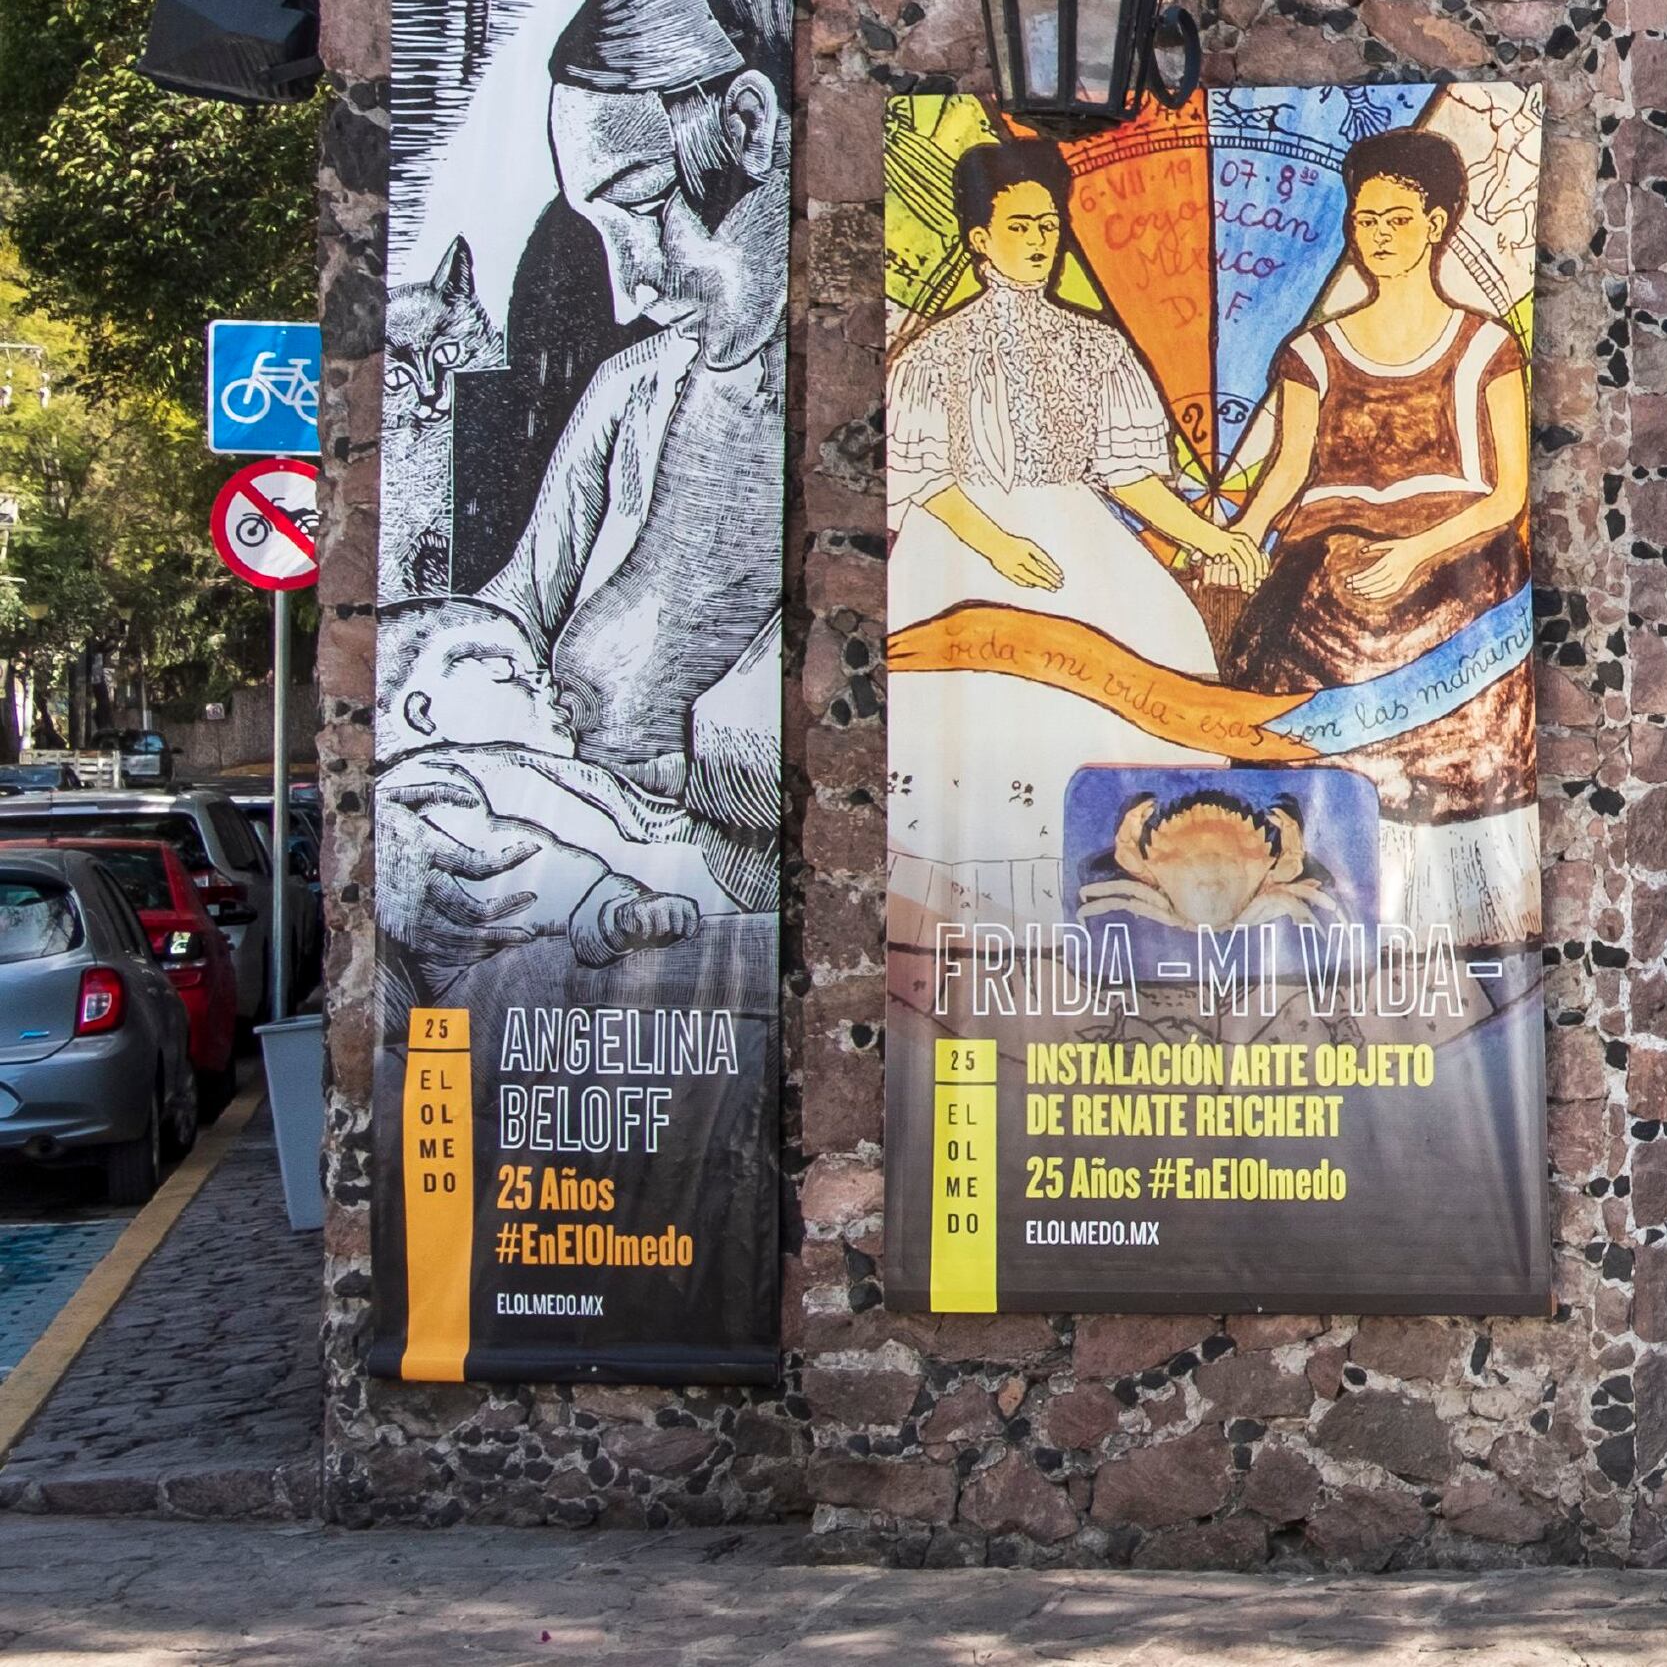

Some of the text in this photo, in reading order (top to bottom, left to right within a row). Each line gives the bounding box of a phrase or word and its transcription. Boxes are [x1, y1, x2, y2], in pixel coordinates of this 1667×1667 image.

[935, 922, 1140, 1017] FRIDA
[424, 1019, 449, 1039] 25
[500, 1006, 739, 1075] ANGELINA
[420, 1070, 453, 1091] EL
[950, 1050, 976, 1072] 25
[1026, 1034, 1434, 1088] INSTALACIÓN ARTE OBJETO
[500, 1085, 673, 1153] BELOFF
[947, 1104, 977, 1126] EL
[1026, 1095, 1343, 1138] DE RENATE REICHERT
[496, 1164, 615, 1212] 25 Años
[1026, 1157, 1347, 1202] 25 Años #EnElOlmedo
[495, 1222, 693, 1267] #EnElOlmedo
[1026, 1220, 1159, 1246] ELOLMEDO.MX
[497, 1293, 604, 1317] ELOLMEDO.MX
